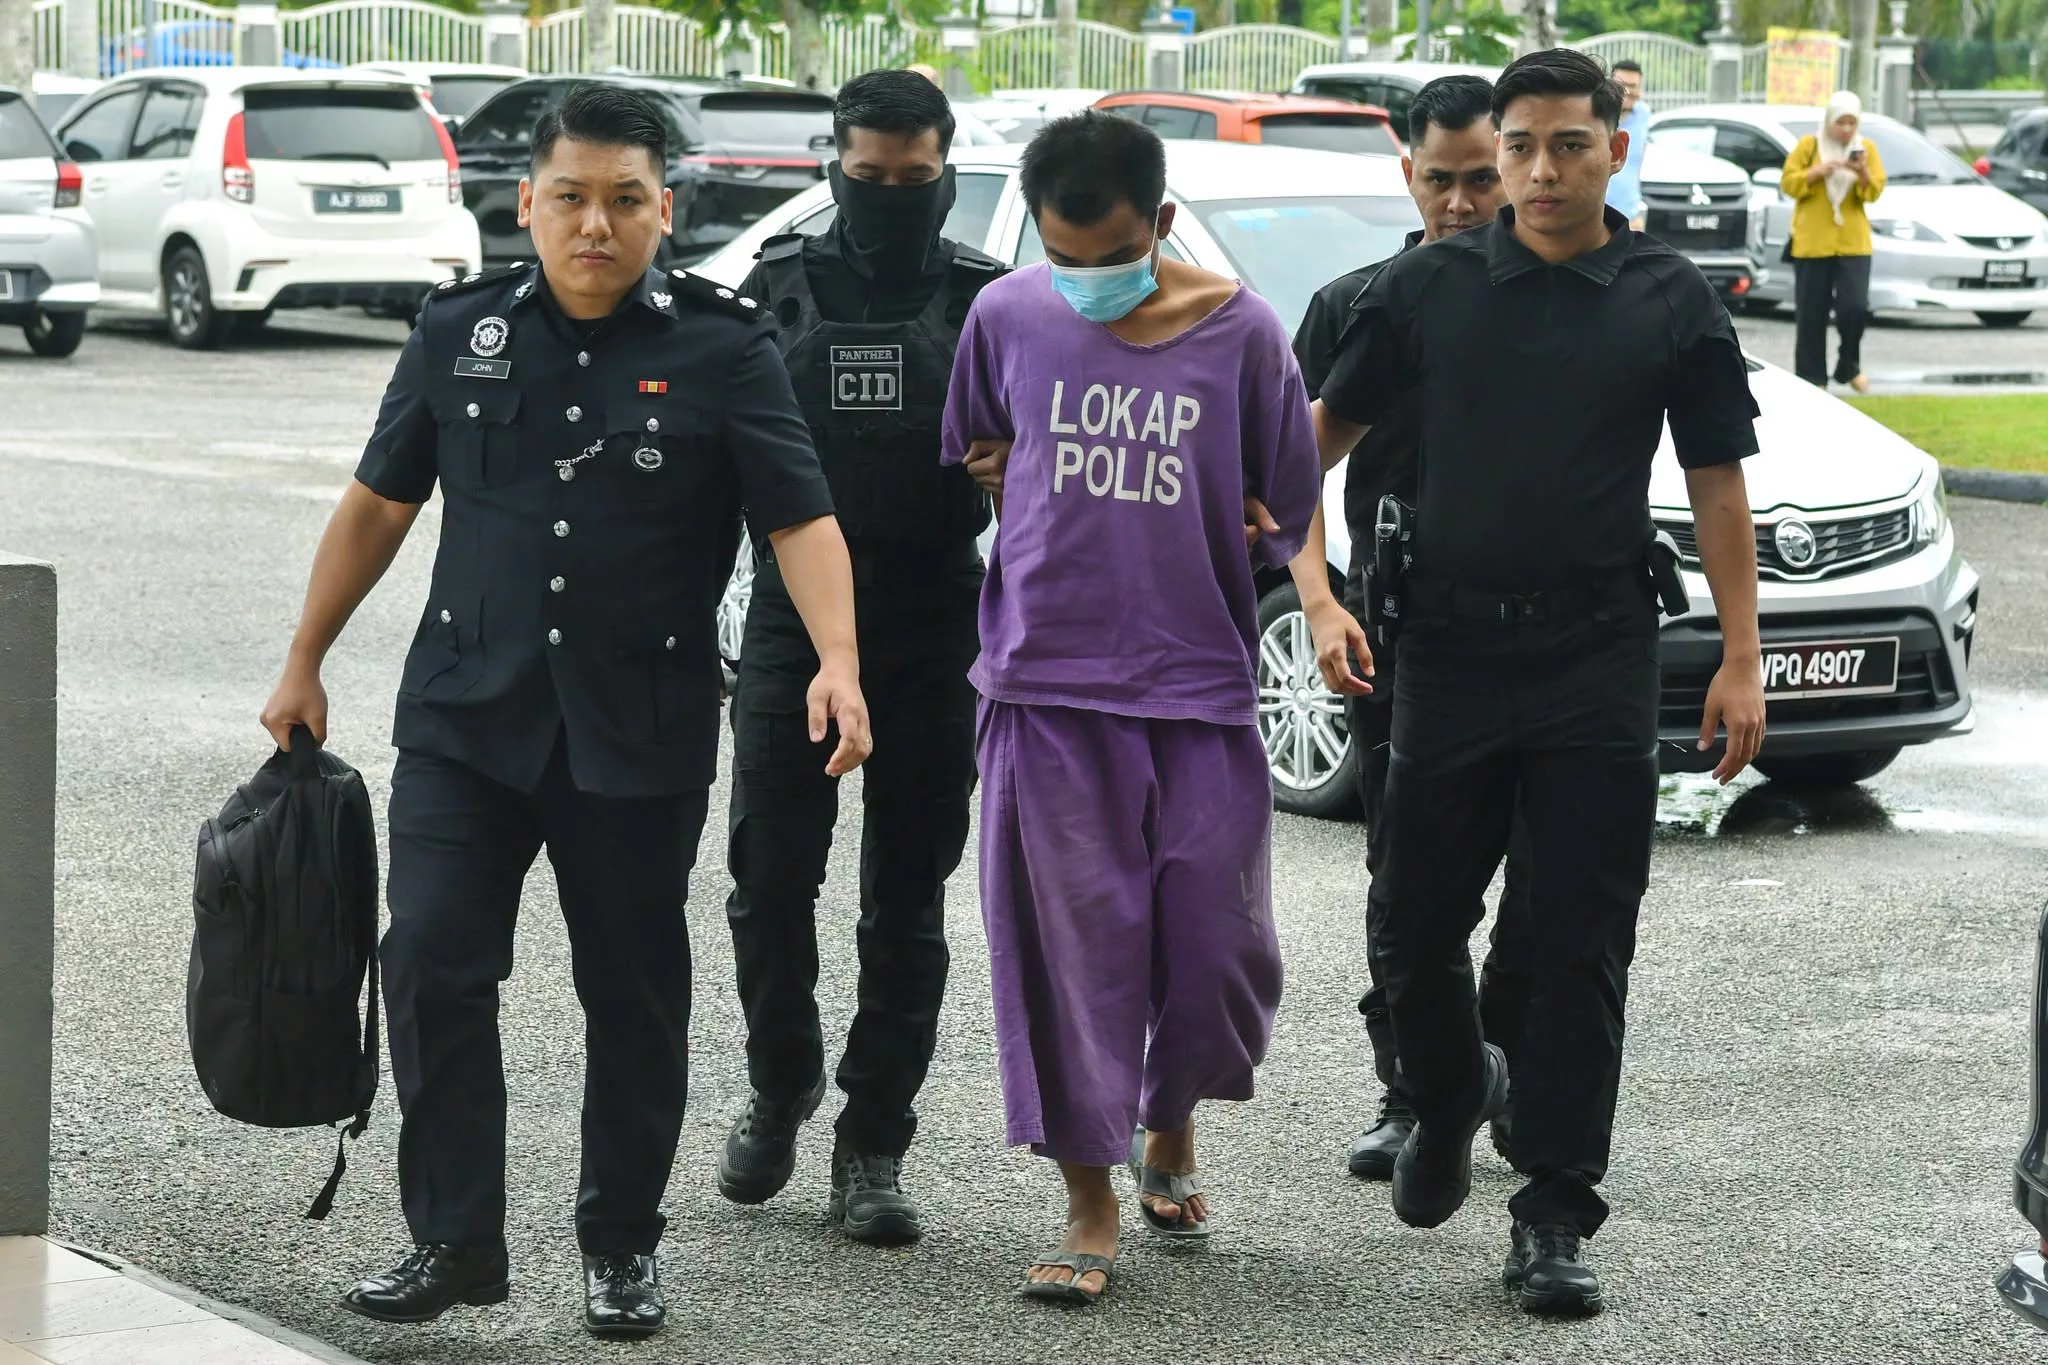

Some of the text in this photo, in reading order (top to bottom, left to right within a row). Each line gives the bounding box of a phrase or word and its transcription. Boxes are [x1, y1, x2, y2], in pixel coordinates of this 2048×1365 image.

[472, 363, 493, 372] JOHN
[839, 350, 893, 360] PANTHER
[838, 373, 896, 401] CID
[1050, 381, 1201, 447] LOKAP
[1054, 441, 1184, 506] POLIS
[1804, 649, 1866, 685] 4907
